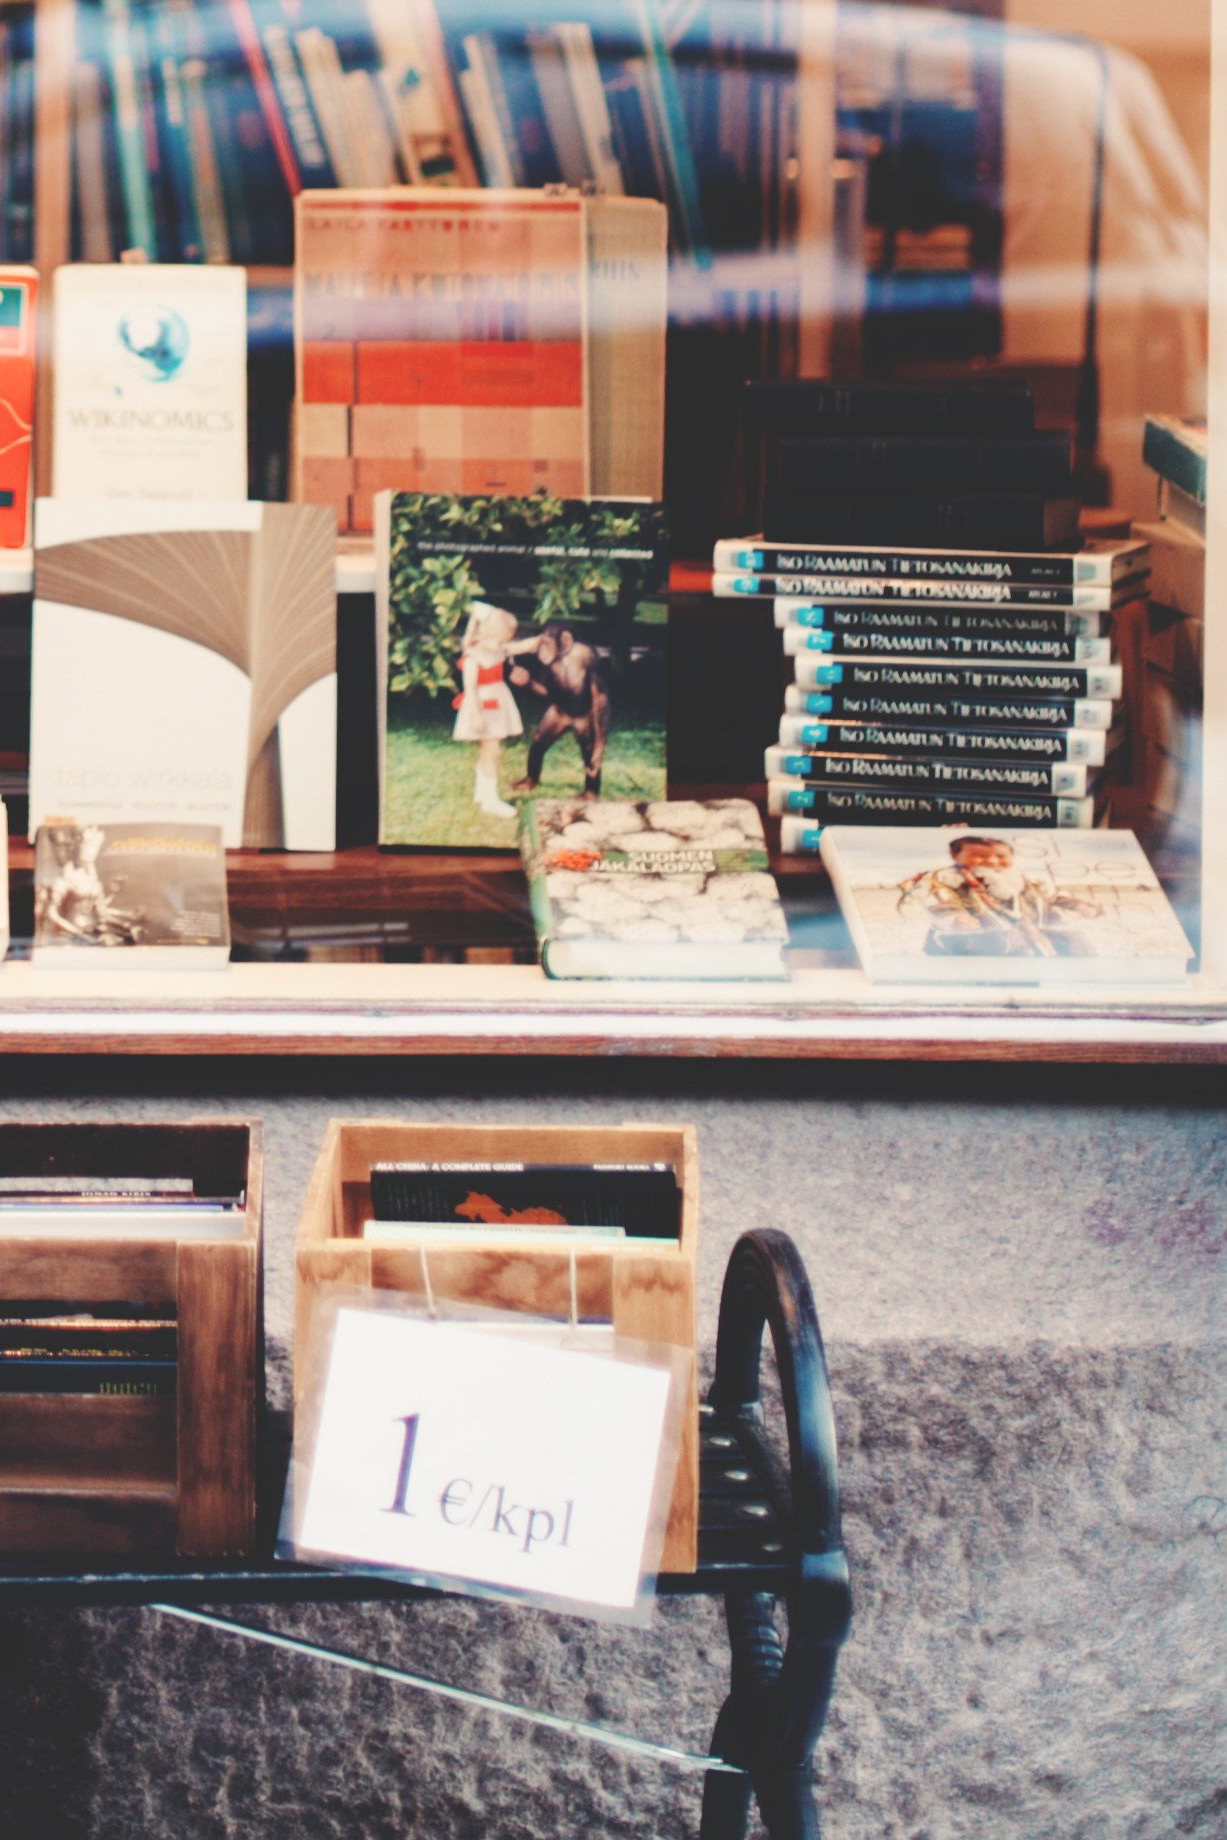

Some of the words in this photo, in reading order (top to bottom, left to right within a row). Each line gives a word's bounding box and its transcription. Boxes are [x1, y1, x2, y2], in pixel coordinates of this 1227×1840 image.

[69, 409, 235, 433] WIKINOMICS
[434, 541, 496, 554] photographed
[497, 543, 525, 553] animal
[804, 554, 886, 573] RAAMATUN
[890, 556, 1013, 580] TIETOSANAKIRJA
[802, 577, 885, 596] RAAMATUN
[891, 579, 1012, 603] TIETOSANAKIRJA
[860, 610, 938, 627] RAAMATUN
[943, 614, 1058, 633] TIETOSANAKIRJA
[870, 634, 949, 651] RAAMATUN
[951, 636, 1070, 658] TIETOSANAKIRJA
[880, 668, 960, 685] RAAMATUN
[962, 670, 1080, 692] TIETOSANAKIRJA
[870, 698, 947, 715] RAAMATUN
[951, 701, 1068, 723] TIETOSANAKIRJA
[866, 728, 944, 747] RAAMATUN
[947, 731, 1063, 754] TIETOSANAKIRJA
[852, 759, 930, 778] RAAMATUN
[931, 762, 1049, 787] TIETOSANAKIRJA
[854, 792, 932, 813] RAAMATUN
[935, 797, 1053, 820] TIETOSANAKIRJA
[627, 849, 714, 862] SUOMEN
[375, 1162, 395, 1172] ALL
[441, 1162, 492, 1172] COMPLETE
[492, 1162, 524, 1172] GUIDE
[379, 1412, 420, 1517] 1
[437, 1477, 573, 1555] €/kpl
